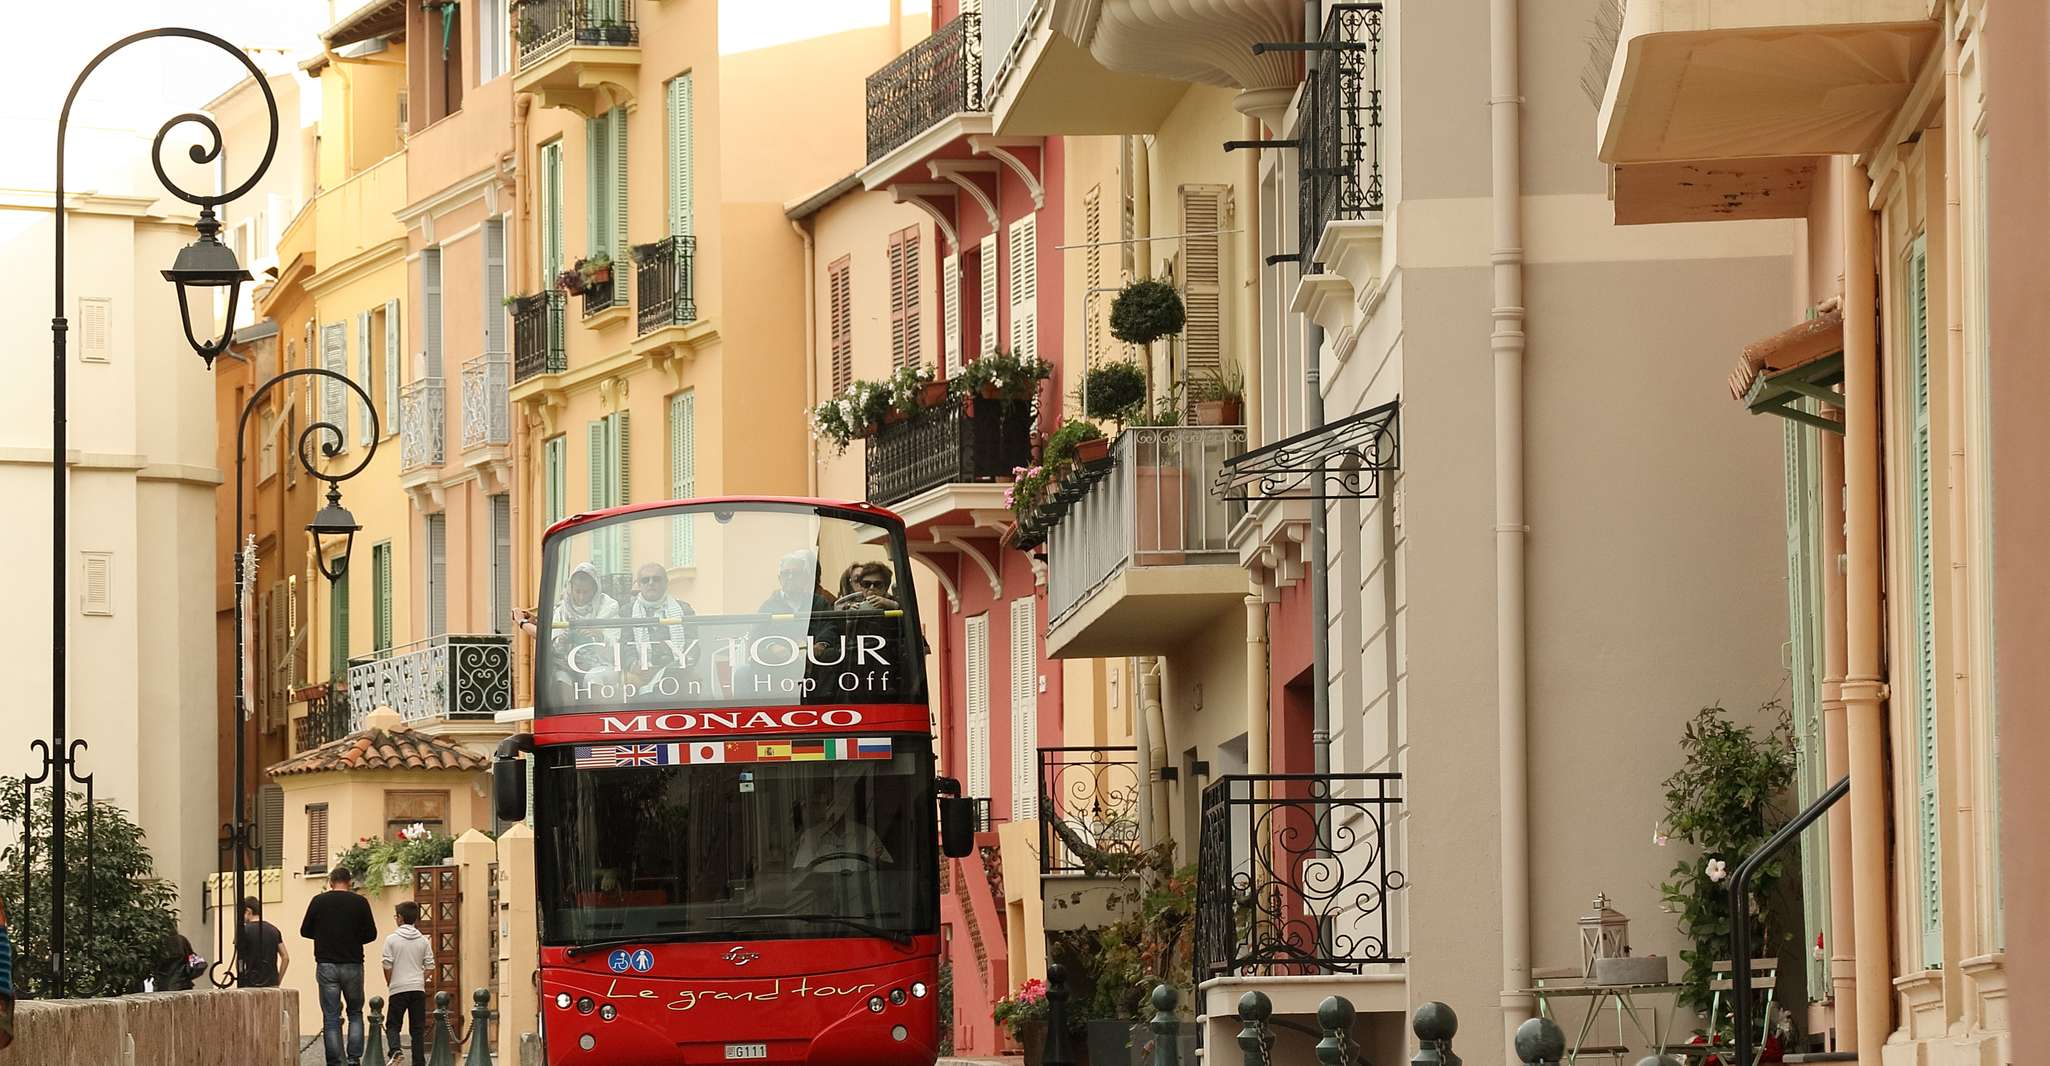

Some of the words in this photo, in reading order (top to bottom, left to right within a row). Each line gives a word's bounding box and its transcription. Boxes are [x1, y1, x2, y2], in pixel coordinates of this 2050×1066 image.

[567, 639, 701, 674] CITY
[716, 634, 892, 667] TOUR
[574, 681, 636, 704] Hop
[658, 676, 701, 696] On
[754, 674, 817, 698] Hop
[838, 670, 889, 691] Off
[599, 709, 863, 734] MONACO
[606, 979, 659, 999] Le
[666, 979, 779, 1011] grand
[792, 977, 876, 998] tour
[736, 1046, 765, 1057] G111
